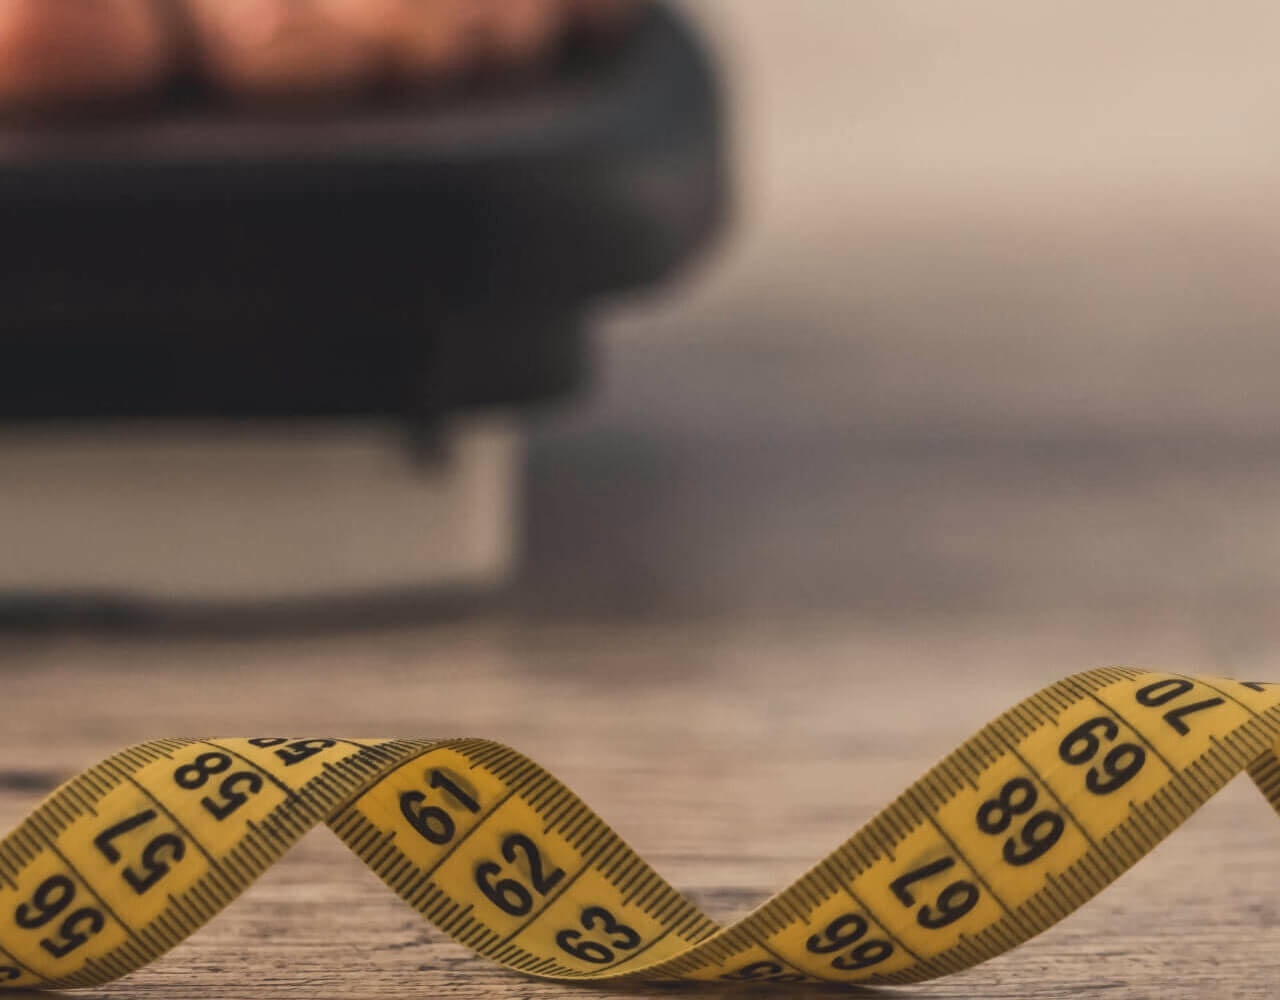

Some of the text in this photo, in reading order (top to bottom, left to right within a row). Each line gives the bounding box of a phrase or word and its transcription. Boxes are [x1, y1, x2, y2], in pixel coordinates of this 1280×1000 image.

[1135, 680, 1223, 735] 70
[174, 752, 262, 821] 58
[1059, 717, 1146, 795] 69
[399, 769, 481, 845] 61
[976, 778, 1065, 866] 68
[95, 809, 185, 895] 57
[474, 833, 566, 917] 62
[15, 875, 105, 959] 56
[890, 857, 979, 929] 67
[555, 906, 641, 964] 63
[806, 914, 894, 971] 66
